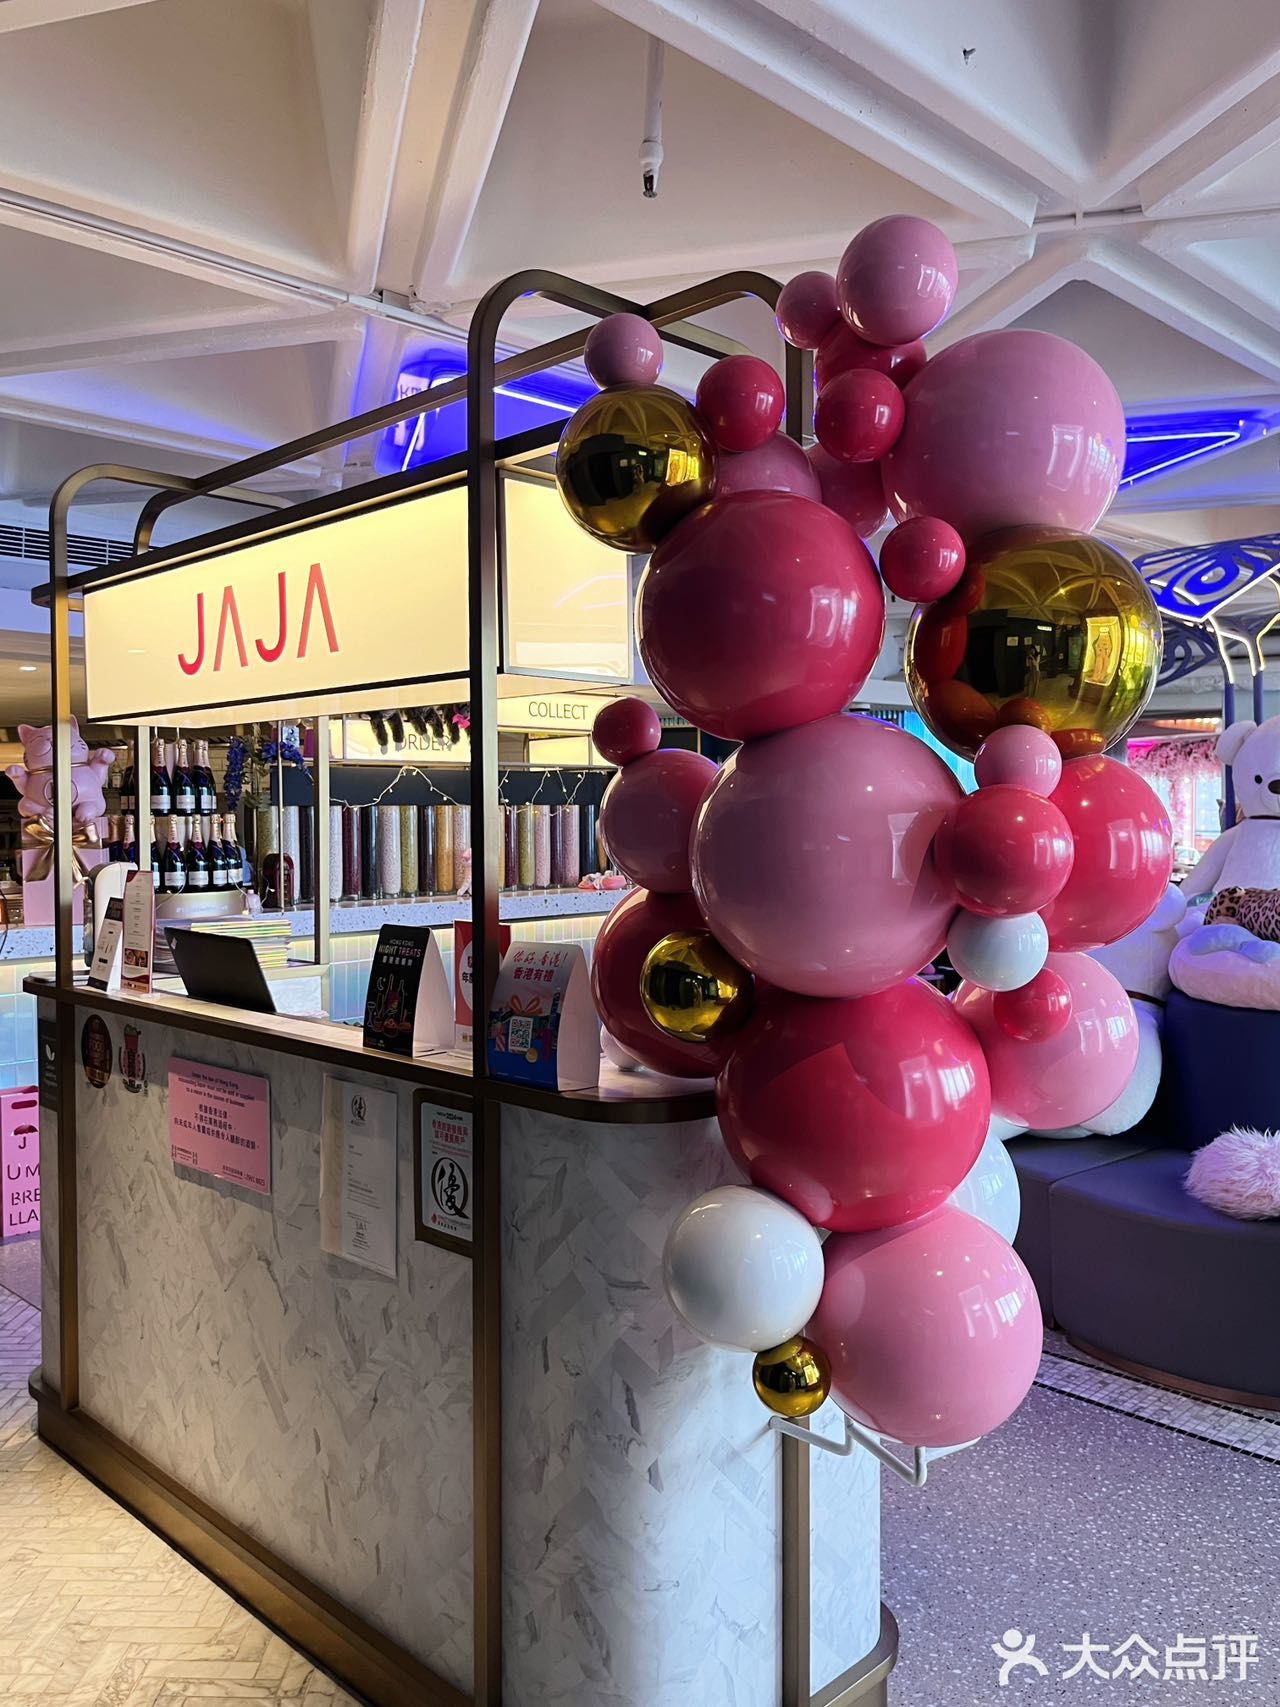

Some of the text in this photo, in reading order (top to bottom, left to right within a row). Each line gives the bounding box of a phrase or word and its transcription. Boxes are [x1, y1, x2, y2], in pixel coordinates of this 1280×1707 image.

[177, 563, 339, 676] JAJA
[528, 701, 589, 720] COLLECT
[378, 944, 422, 957] NIGHT TREATS
[9, 1209, 39, 1226] LLA
